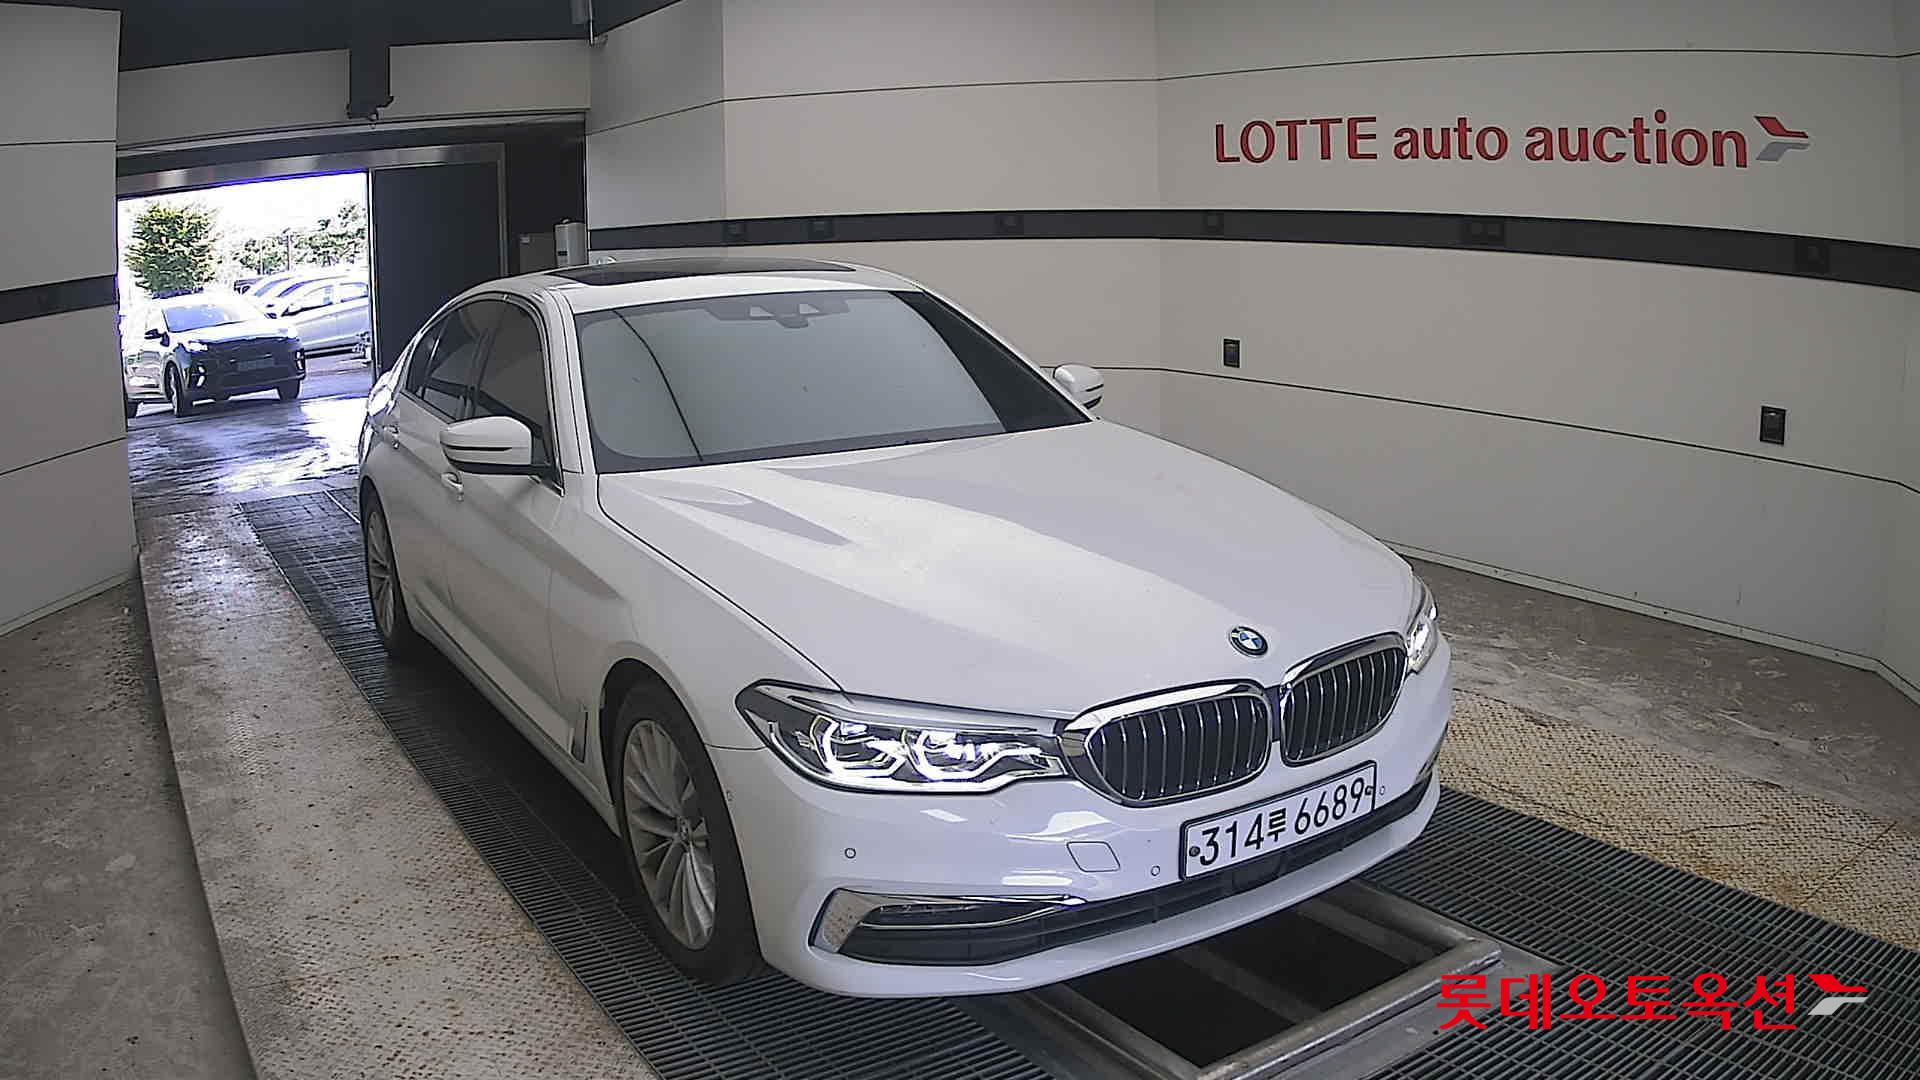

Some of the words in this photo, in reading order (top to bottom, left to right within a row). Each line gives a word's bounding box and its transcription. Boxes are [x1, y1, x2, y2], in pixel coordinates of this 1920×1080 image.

[1215, 116, 1378, 163] LOTTE
[1393, 116, 1509, 161] auto
[1524, 109, 1748, 168] auction
[1199, 808, 1287, 866] 314루
[1294, 777, 1365, 835] 6689
